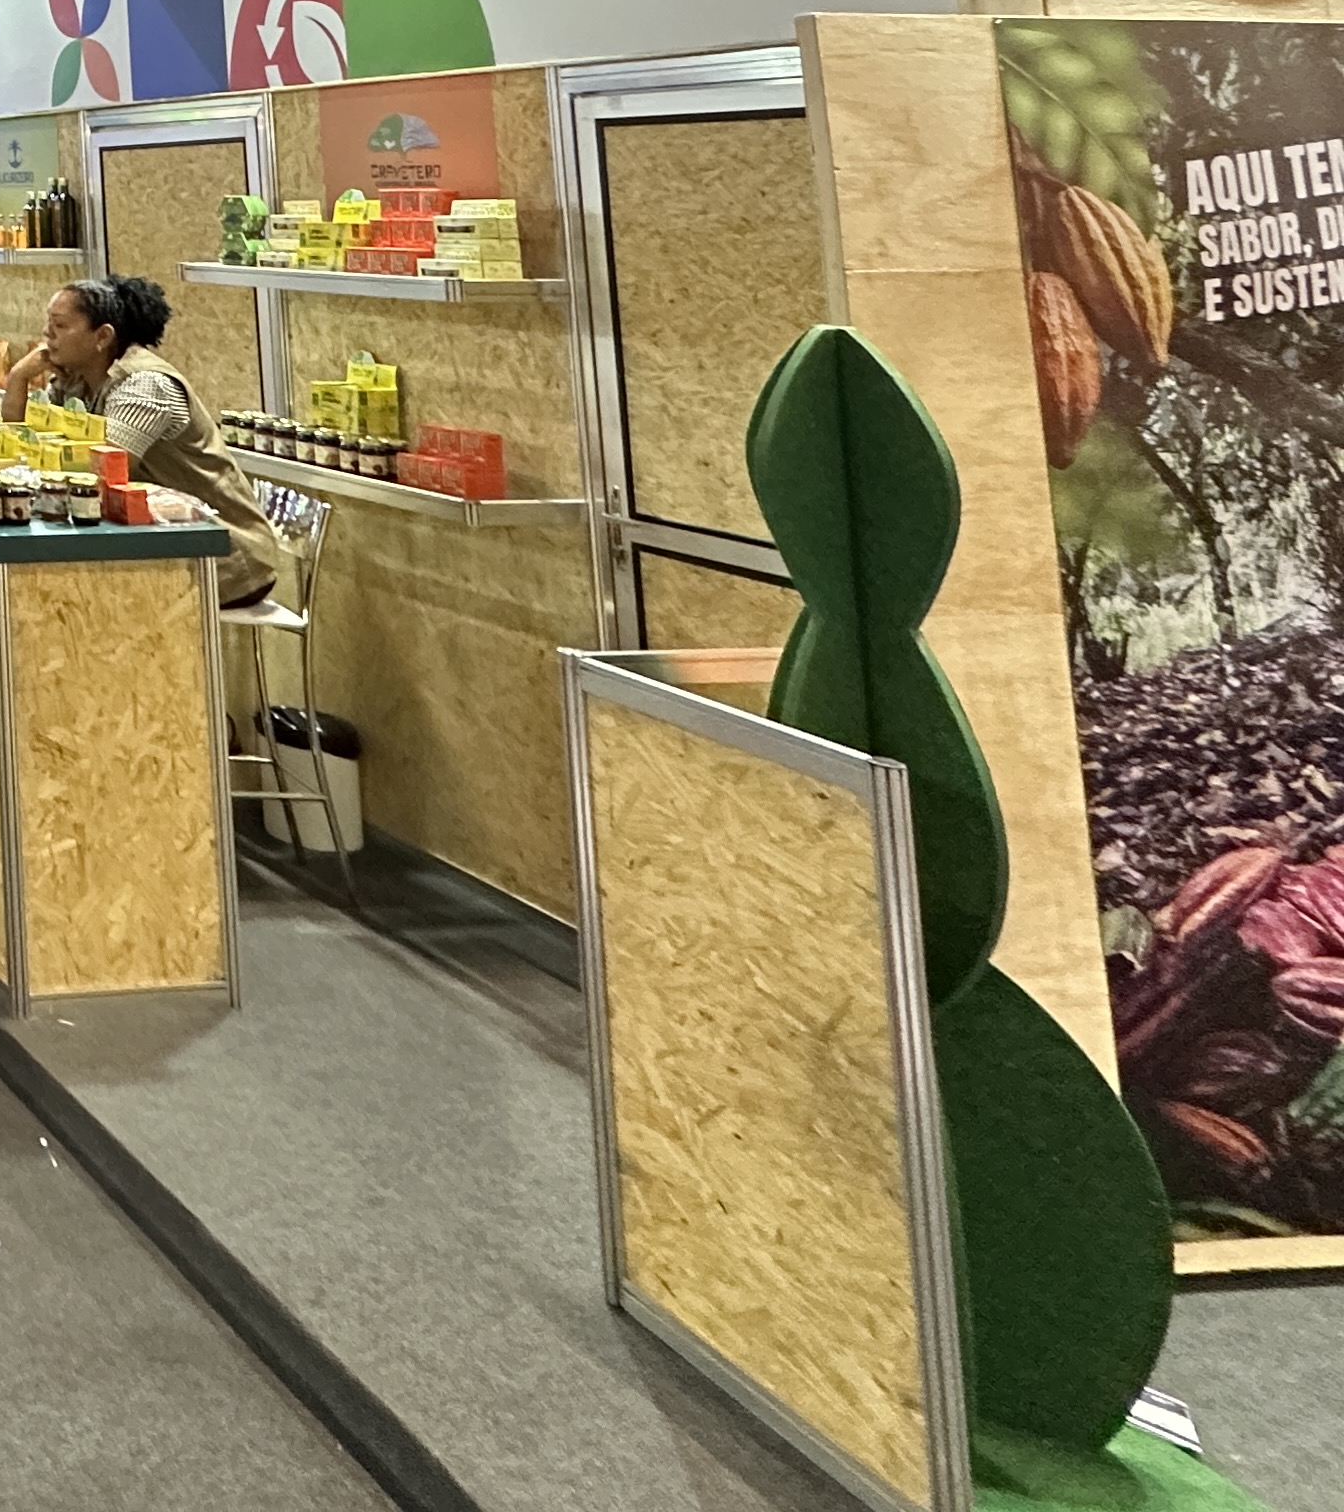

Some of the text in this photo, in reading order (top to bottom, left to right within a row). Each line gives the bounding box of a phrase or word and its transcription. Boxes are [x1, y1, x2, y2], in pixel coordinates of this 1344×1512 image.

[1186, 149, 1279, 215] AQUI
[1198, 212, 1313, 267] SABOR,
[1204, 278, 1225, 322] E
